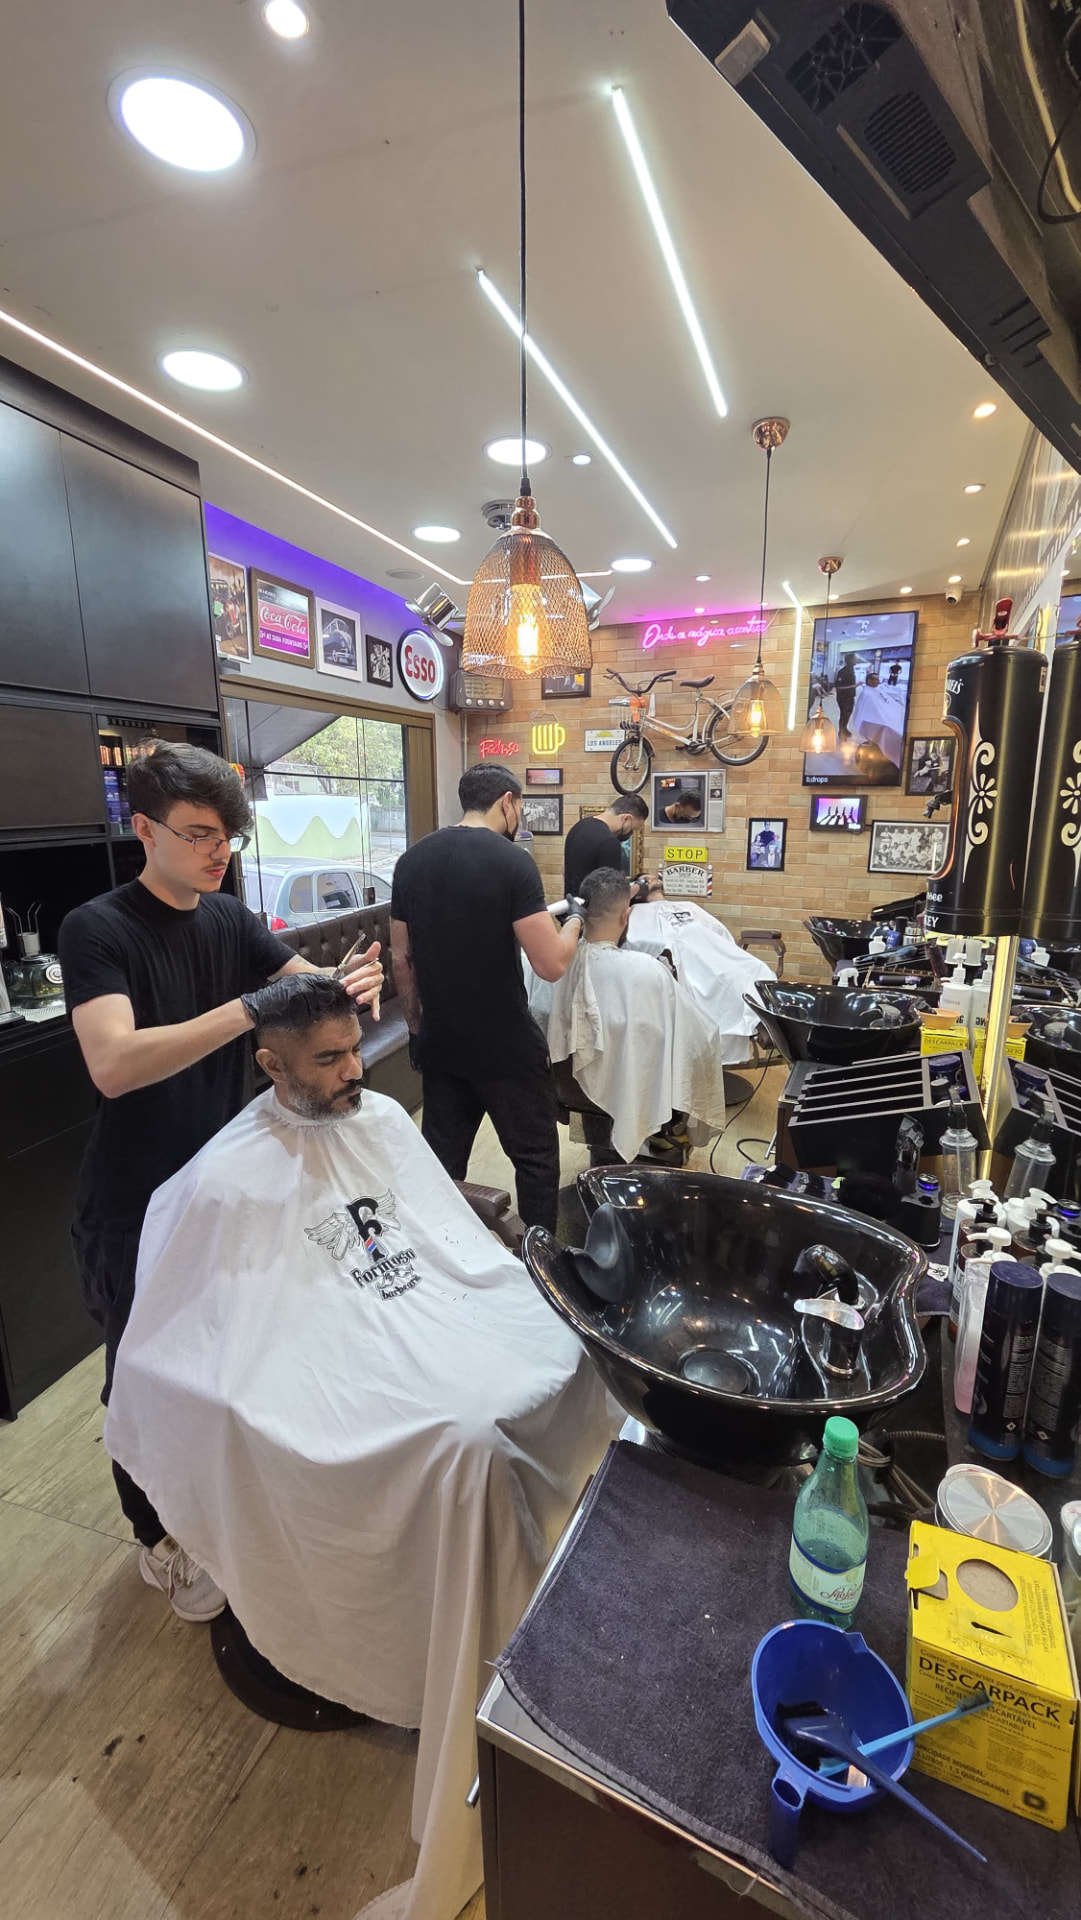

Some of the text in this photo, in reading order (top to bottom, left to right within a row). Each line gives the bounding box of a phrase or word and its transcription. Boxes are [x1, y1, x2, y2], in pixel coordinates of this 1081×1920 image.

[260, 606, 306, 635] Coca-Cola
[667, 849, 703, 860] STOP
[666, 866, 704, 877] BARBER
[919, 1648, 947, 1664] Coletor
[949, 1660, 958, 1669] de
[918, 1656, 1060, 1723] DESCARPACK
[986, 1703, 1036, 1729] ESCARTÁVEL
[914, 1742, 949, 1762] APACIDADE
